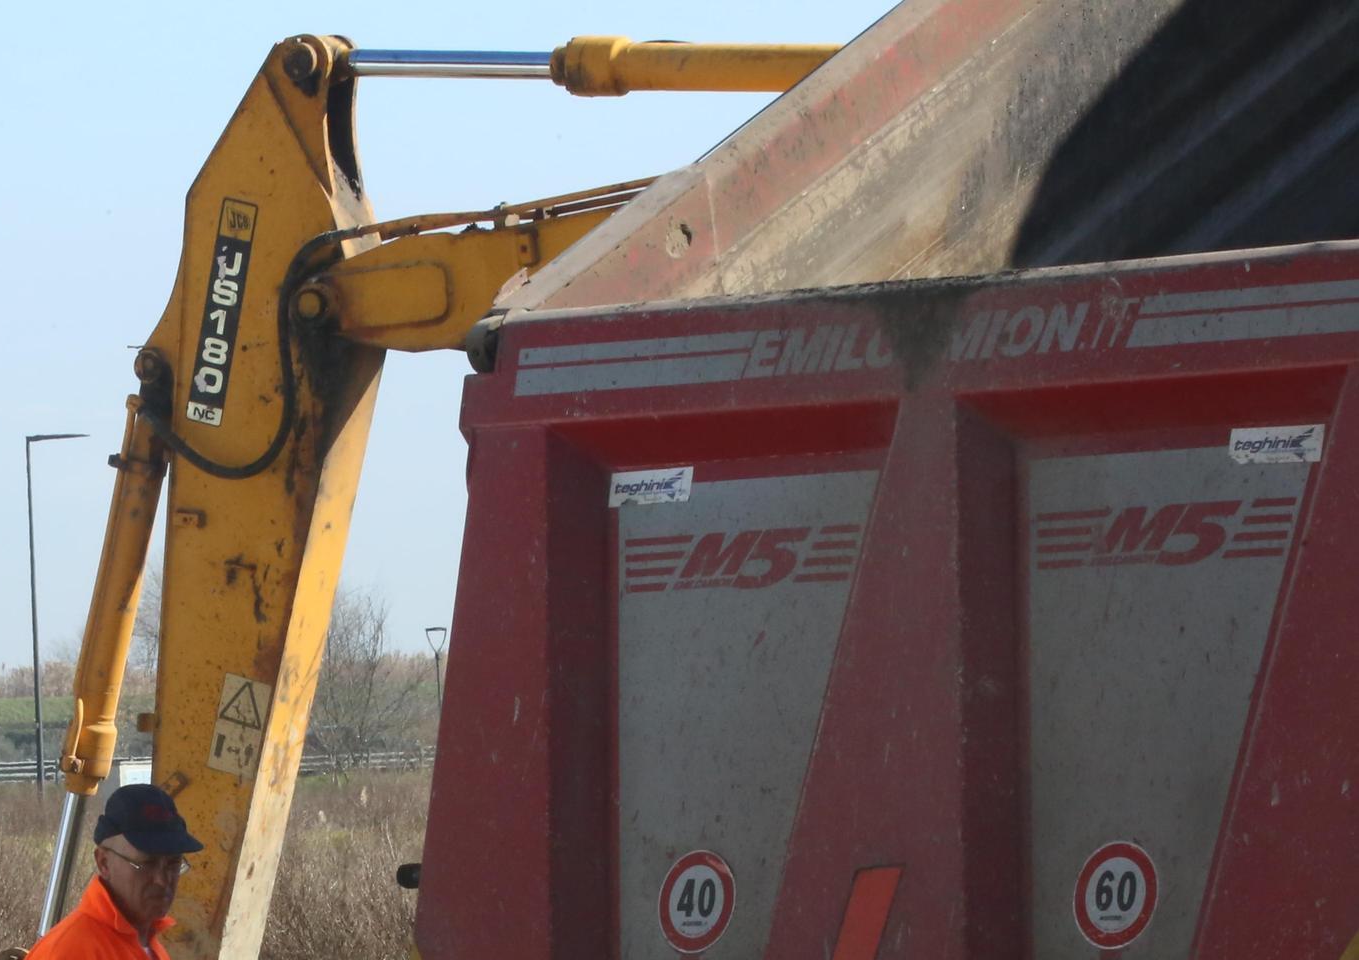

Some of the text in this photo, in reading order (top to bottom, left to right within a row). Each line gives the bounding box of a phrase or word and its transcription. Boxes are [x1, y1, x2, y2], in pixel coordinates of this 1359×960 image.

[194, 251, 243, 394] JS180
[743, 296, 1140, 379] EMILCMION.IT
[192, 406, 216, 421] NC
[1233, 435, 1294, 454] teghini
[614, 478, 668, 496] teghini
[1104, 500, 1242, 567] M5
[679, 525, 812, 590] M5
[677, 878, 716, 918] 40
[1095, 870, 1137, 912] 60
